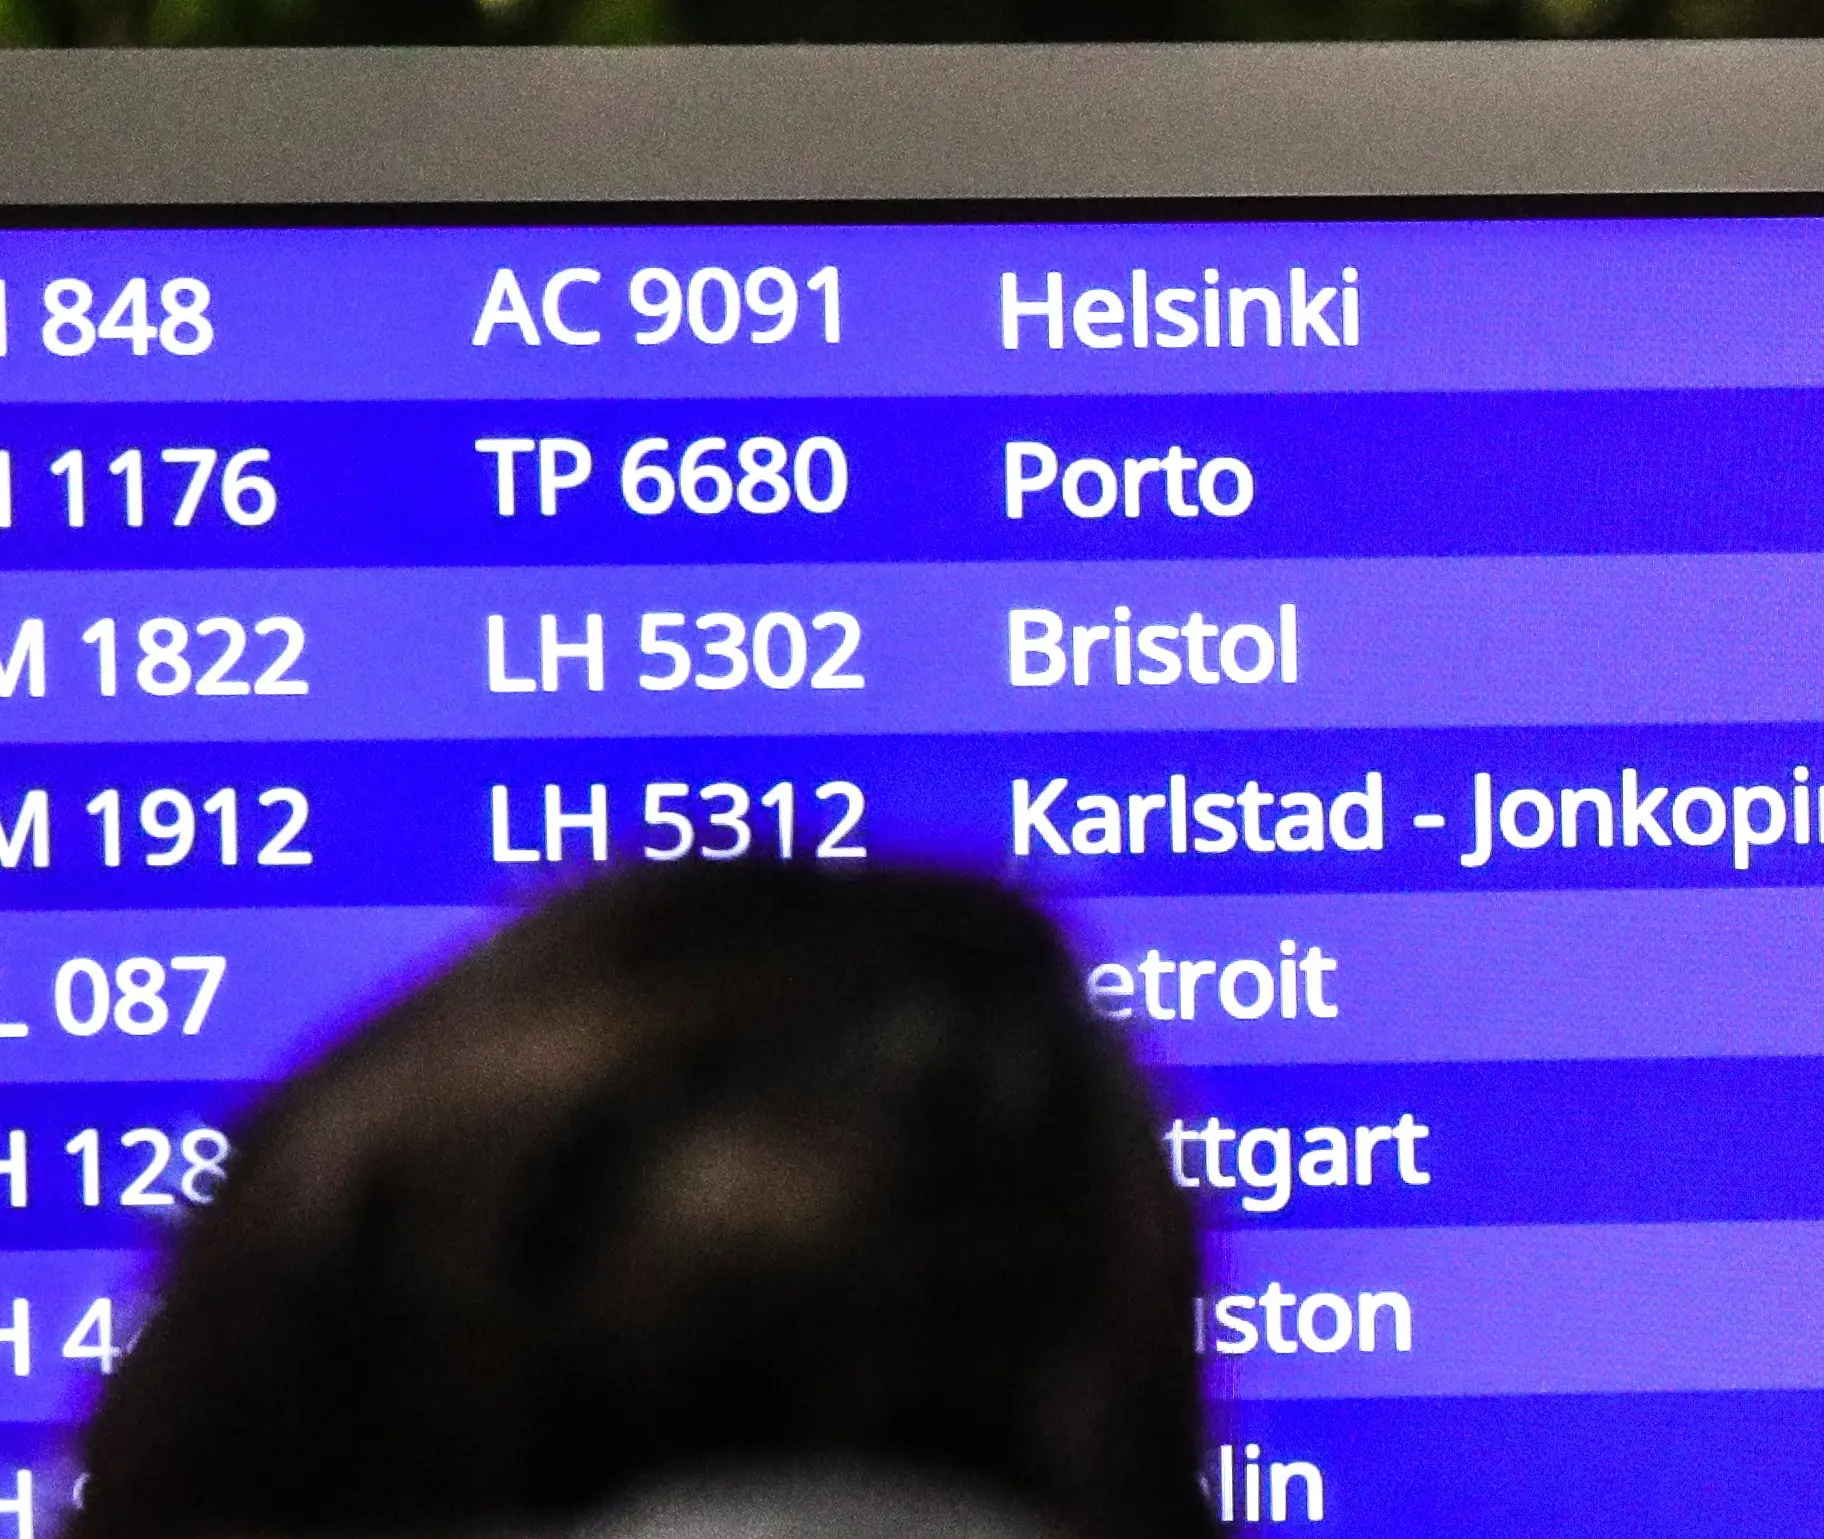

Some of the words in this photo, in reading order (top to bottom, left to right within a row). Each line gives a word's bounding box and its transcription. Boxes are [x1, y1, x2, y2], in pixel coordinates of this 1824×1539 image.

[42, 278, 214, 356] 848
[473, 268, 600, 346] AC
[629, 266, 840, 345] 9091
[1000, 267, 1361, 349] Helsinki
[51, 449, 277, 527] 1176
[475, 438, 592, 516] TP
[620, 436, 848, 515] 6680
[1004, 441, 1254, 519] Porto
[82, 615, 309, 697] 1822
[486, 613, 605, 693] LH
[639, 610, 866, 691] 5302
[1007, 602, 1299, 686] Bristol
[87, 788, 312, 867] 1912
[491, 784, 608, 862] LH
[643, 781, 866, 862] 5312
[1011, 771, 1385, 856] Karlstad
[1414, 807, 1444, 822] -
[54, 955, 226, 1036] 087
[1087, 938, 1339, 1020] etroit
